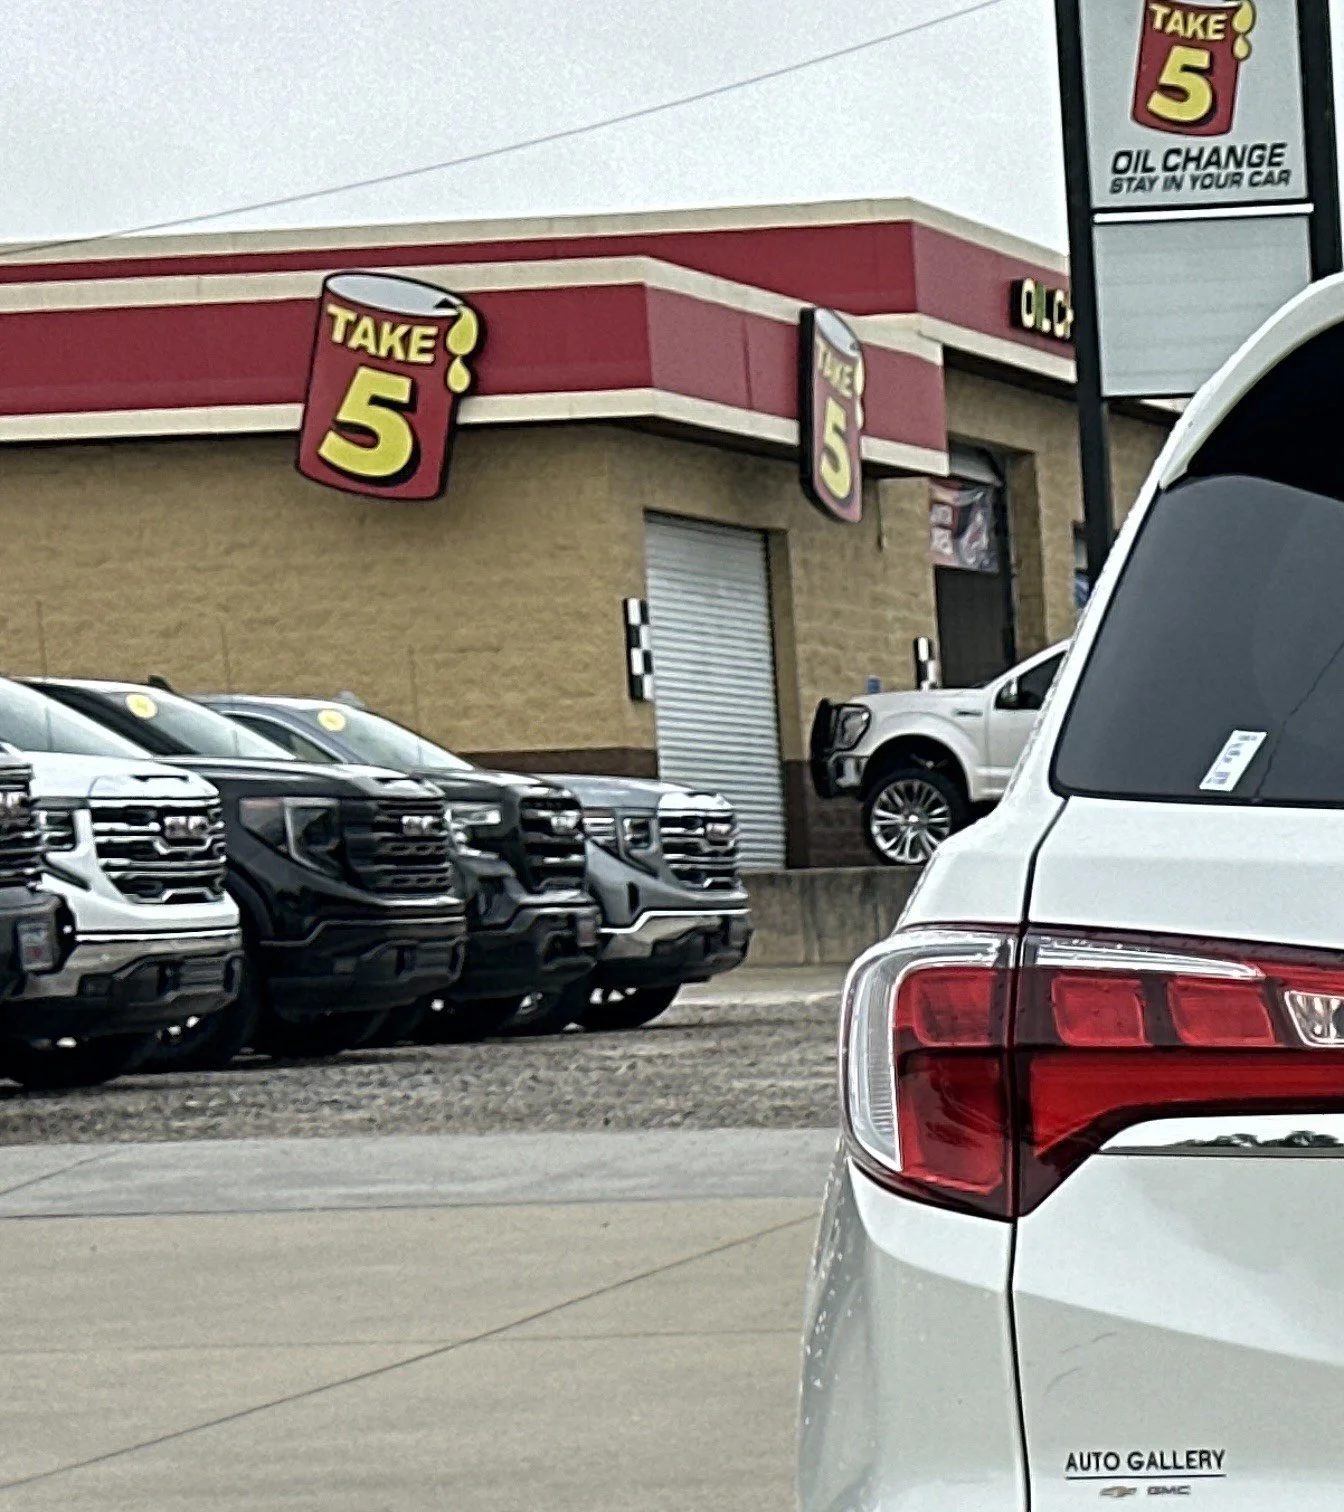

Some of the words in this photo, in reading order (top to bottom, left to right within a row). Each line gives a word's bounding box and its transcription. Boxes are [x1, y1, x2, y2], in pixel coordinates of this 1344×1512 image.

[1149, 4, 1227, 41] TAKE
[1147, 45, 1213, 122] 5
[1111, 149, 1157, 174] OIL
[1162, 142, 1288, 172] CHANGE
[1109, 175, 1158, 194] STAY
[1162, 173, 1185, 190] IN
[1190, 170, 1243, 190] YOUR
[1247, 169, 1293, 188] CAR
[327, 303, 439, 364] TAKE
[317, 365, 415, 478] 5
[819, 396, 851, 500] 5
[1065, 1452, 1120, 1472] AUTO
[1127, 1449, 1225, 1471] GALLERY
[1147, 1486, 1191, 1496] GMC
